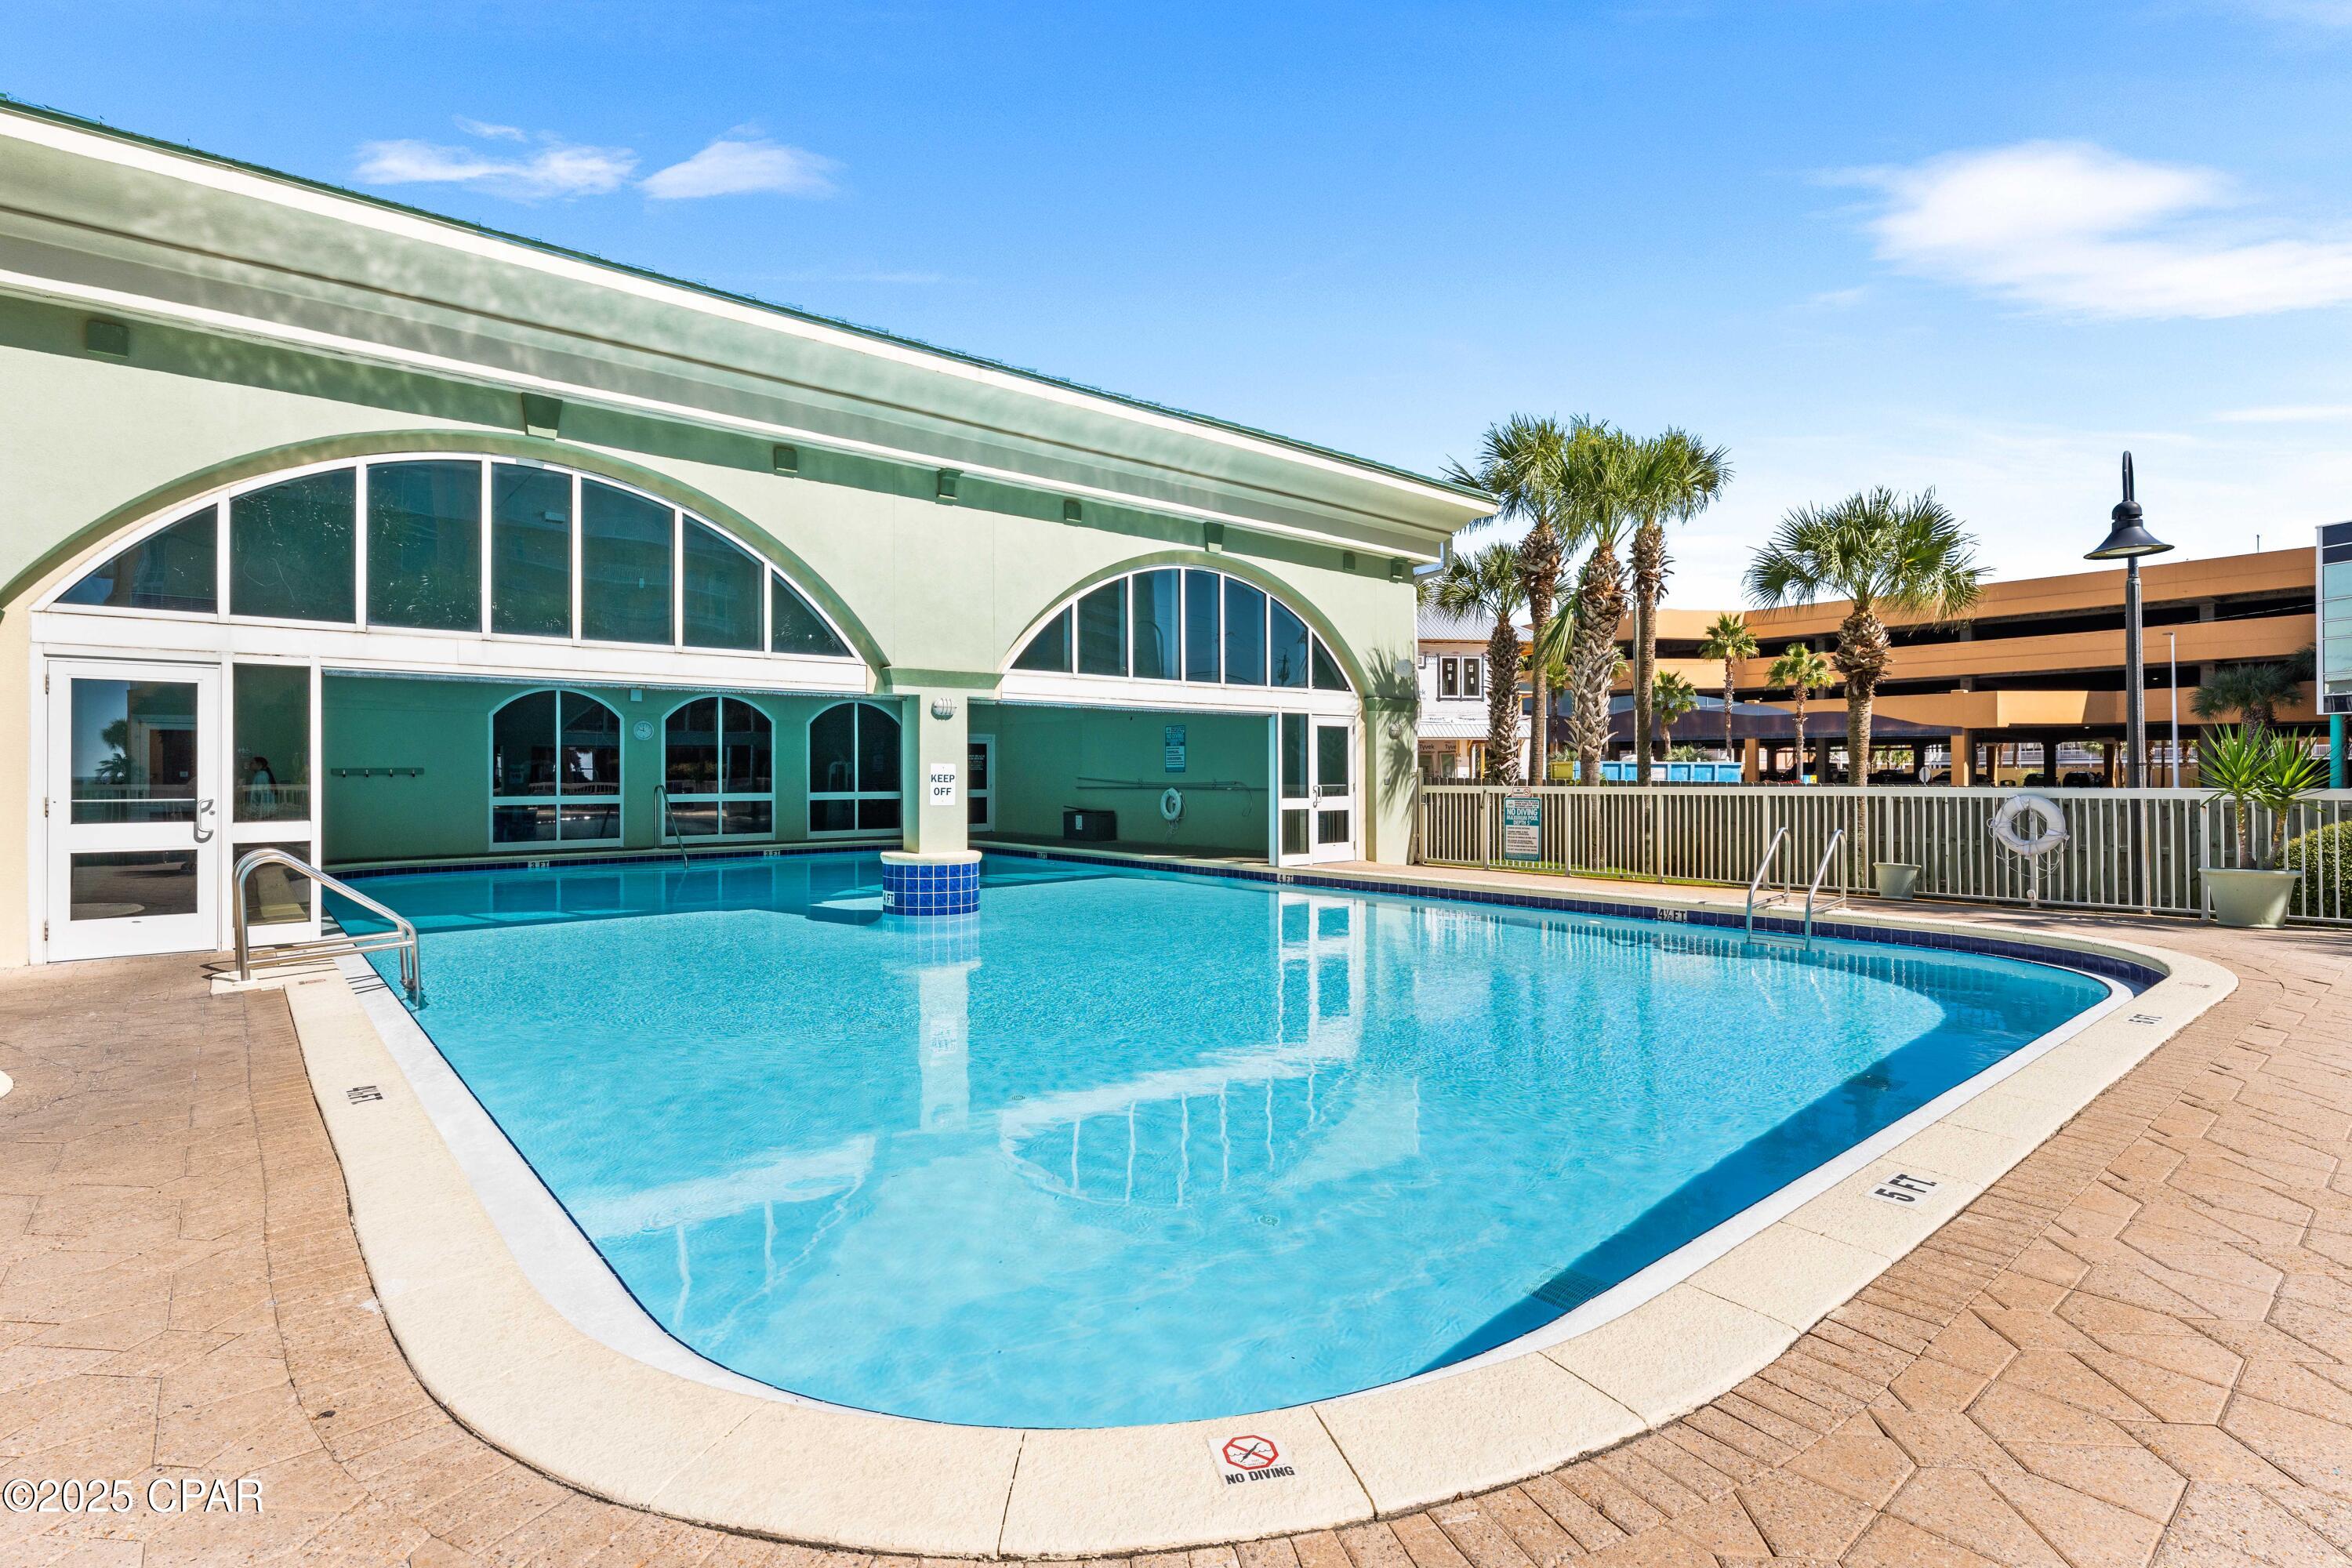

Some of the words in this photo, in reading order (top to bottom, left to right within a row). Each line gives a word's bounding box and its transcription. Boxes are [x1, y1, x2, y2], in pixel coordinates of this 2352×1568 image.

[931, 774, 955, 783] KEEP
[934, 787, 952, 796] OFF
[1279, 874, 1283, 884] 4
[1874, 1188, 1916, 1203] 5
[1225, 1472, 1245, 1485] NO
[1247, 1465, 1296, 1482] DIVING
